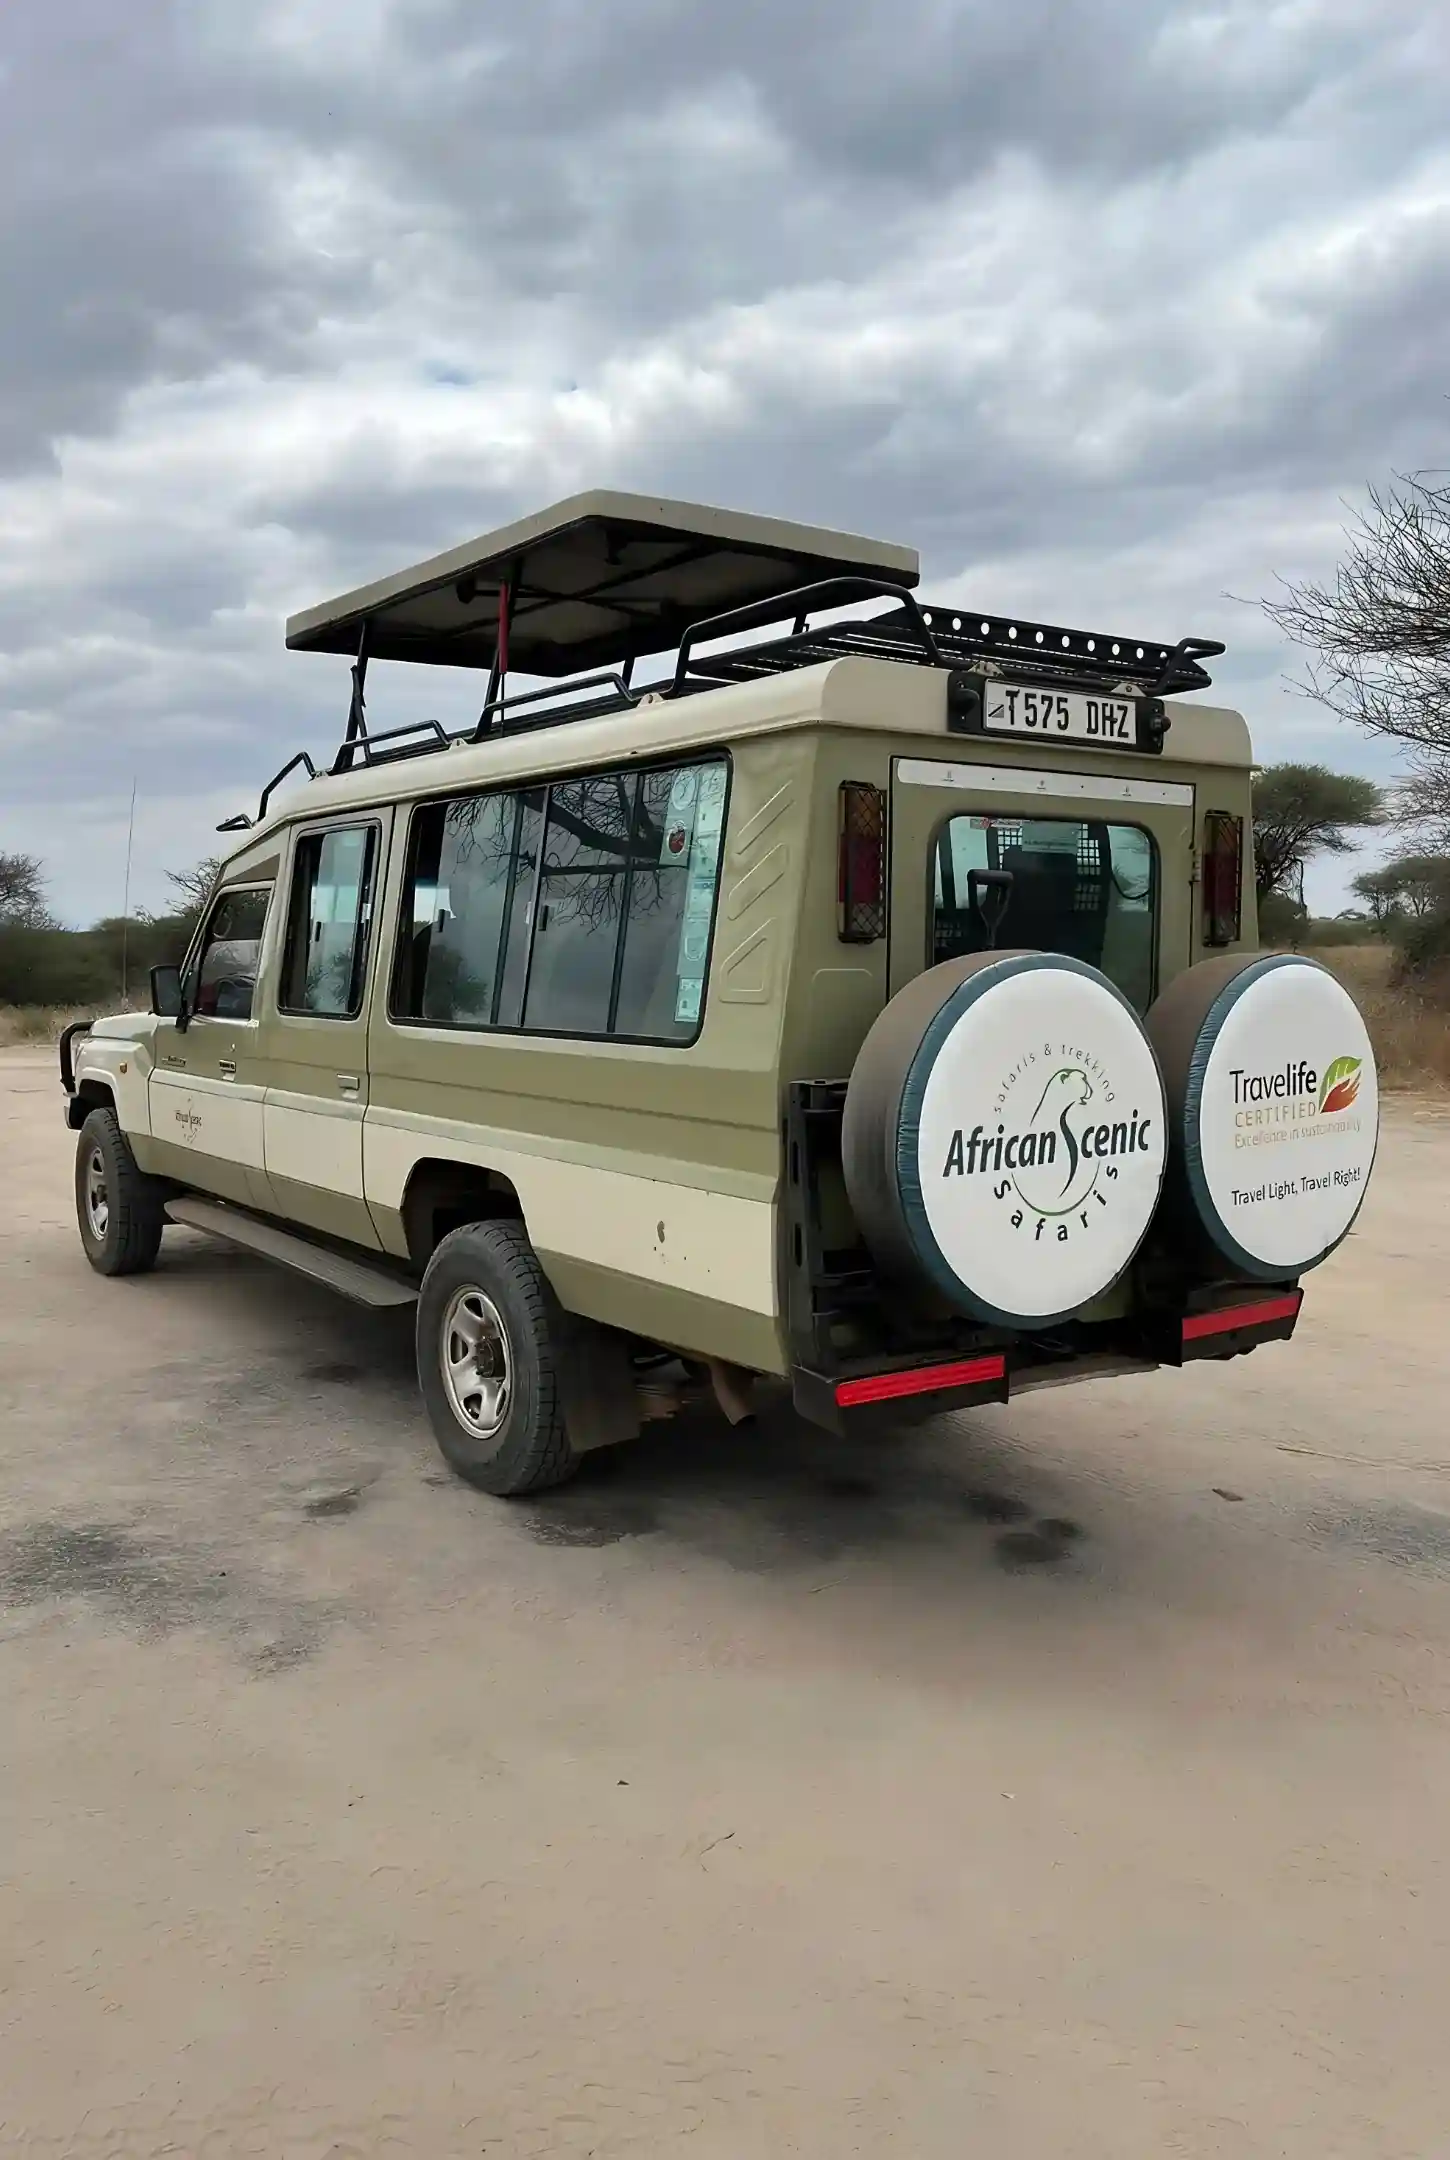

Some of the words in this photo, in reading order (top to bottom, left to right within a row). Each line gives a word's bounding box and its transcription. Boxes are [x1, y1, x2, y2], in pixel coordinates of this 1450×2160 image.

[1086, 700, 1129, 738] DHZ
[1044, 1043, 1052, 1055] &
[1061, 1044, 1115, 1103] trekking
[1229, 1061, 1317, 1104] Travelife
[1235, 1101, 1316, 1128] CERTIFIED
[1289, 1128, 1299, 1140] in
[1301, 1118, 1361, 1138] sustainabity
[1231, 1184, 1265, 1205] Travel
[1269, 1181, 1298, 1200] Light,
[1301, 1172, 1330, 1190] Travel
[1333, 1167, 1361, 1187] Right!
